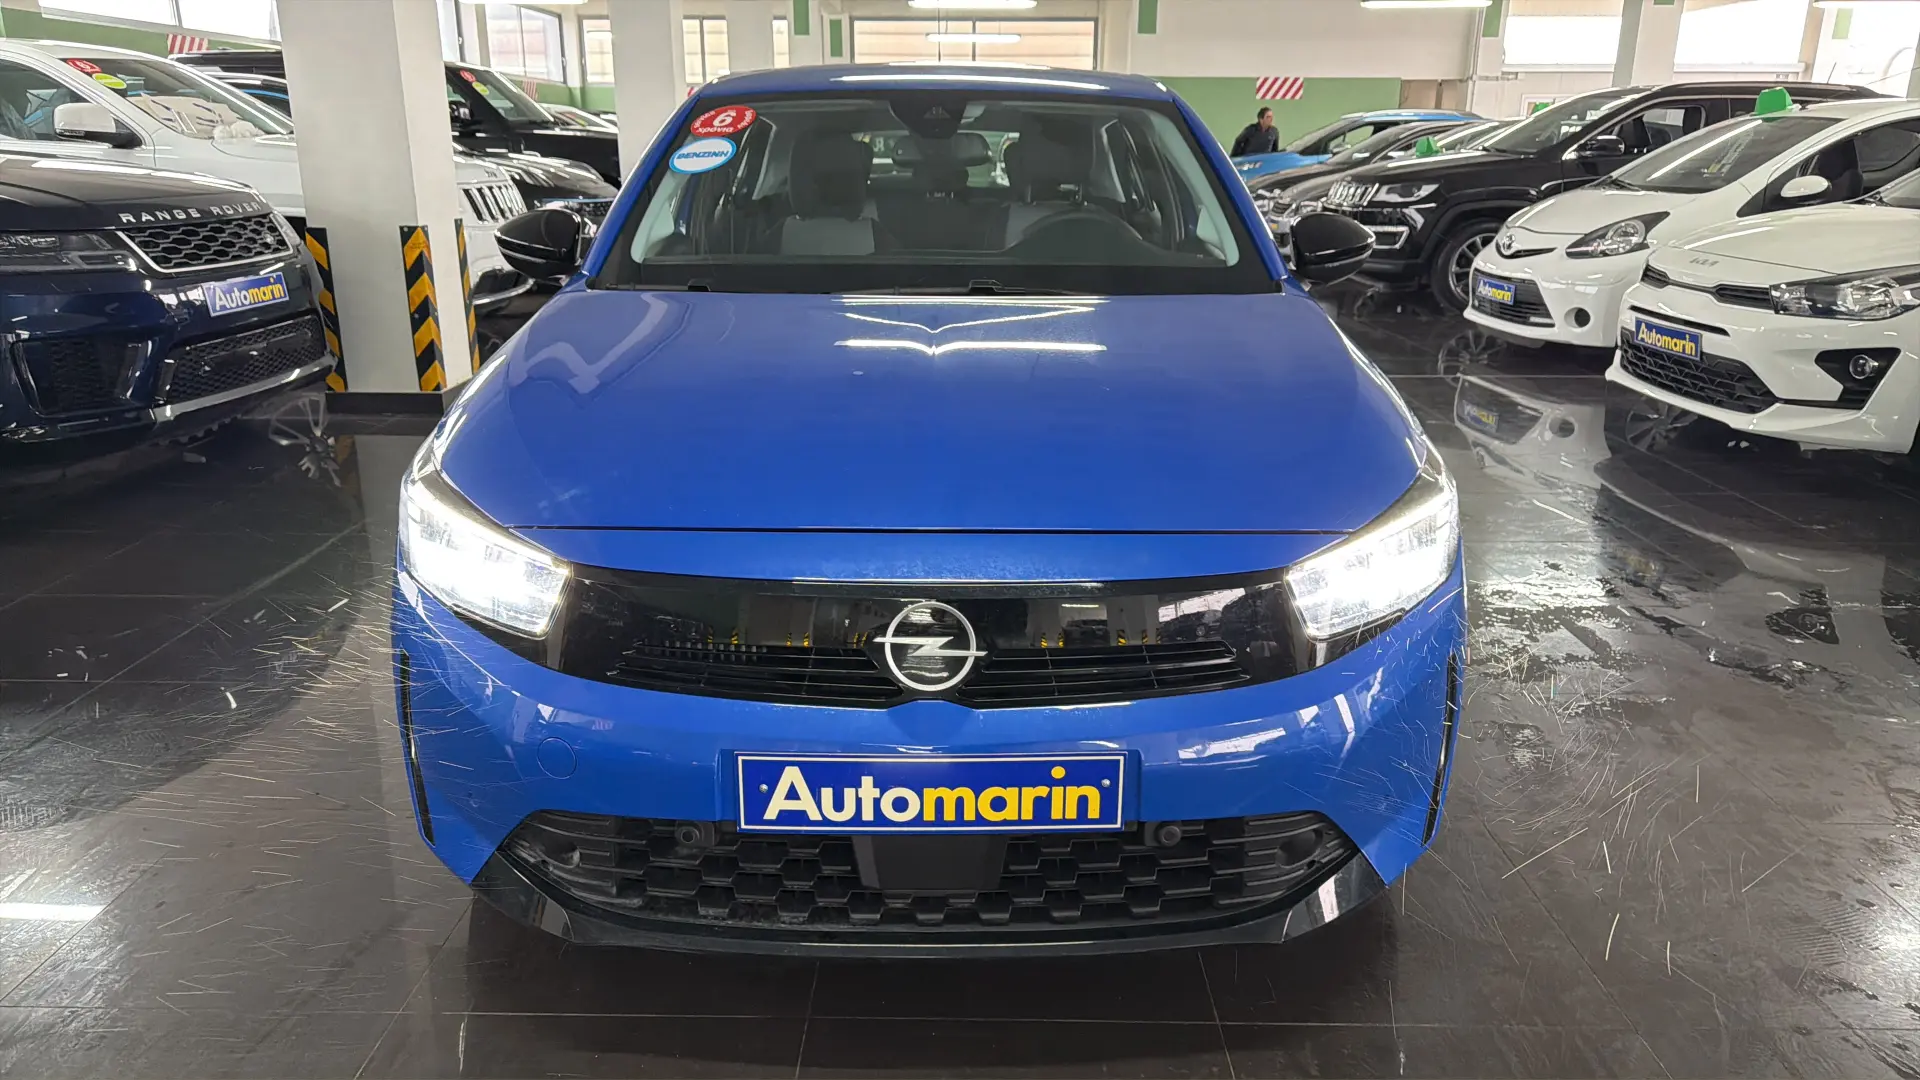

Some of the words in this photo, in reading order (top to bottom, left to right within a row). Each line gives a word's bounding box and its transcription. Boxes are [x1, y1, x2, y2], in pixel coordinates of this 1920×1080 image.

[713, 111, 737, 127] 6
[118, 207, 202, 224] RANGE
[209, 201, 261, 216] ROVER
[214, 276, 285, 311] Automarin
[1477, 279, 1513, 302] Automarin
[1637, 322, 1696, 356] Automarin
[762, 765, 1101, 822] Automarin
